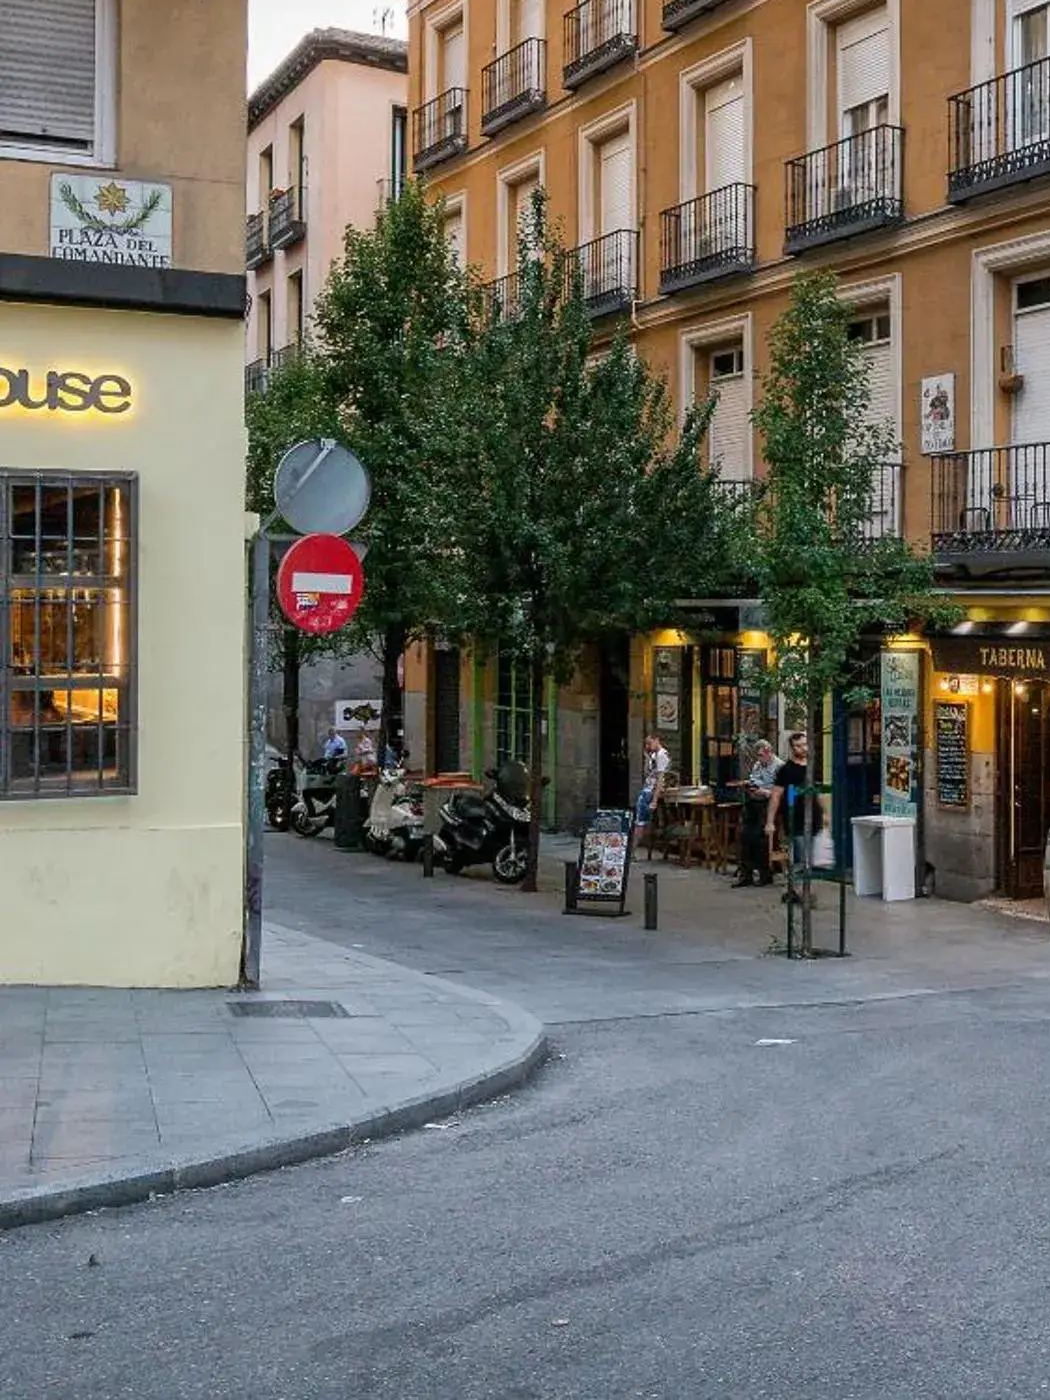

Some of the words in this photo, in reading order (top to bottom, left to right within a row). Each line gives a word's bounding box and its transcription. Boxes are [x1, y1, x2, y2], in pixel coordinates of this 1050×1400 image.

[58, 228, 118, 249] PLAZA
[126, 239, 158, 253] DEL
[52, 245, 170, 269] COMANDANTE
[980, 647, 1046, 670] TABERNA
